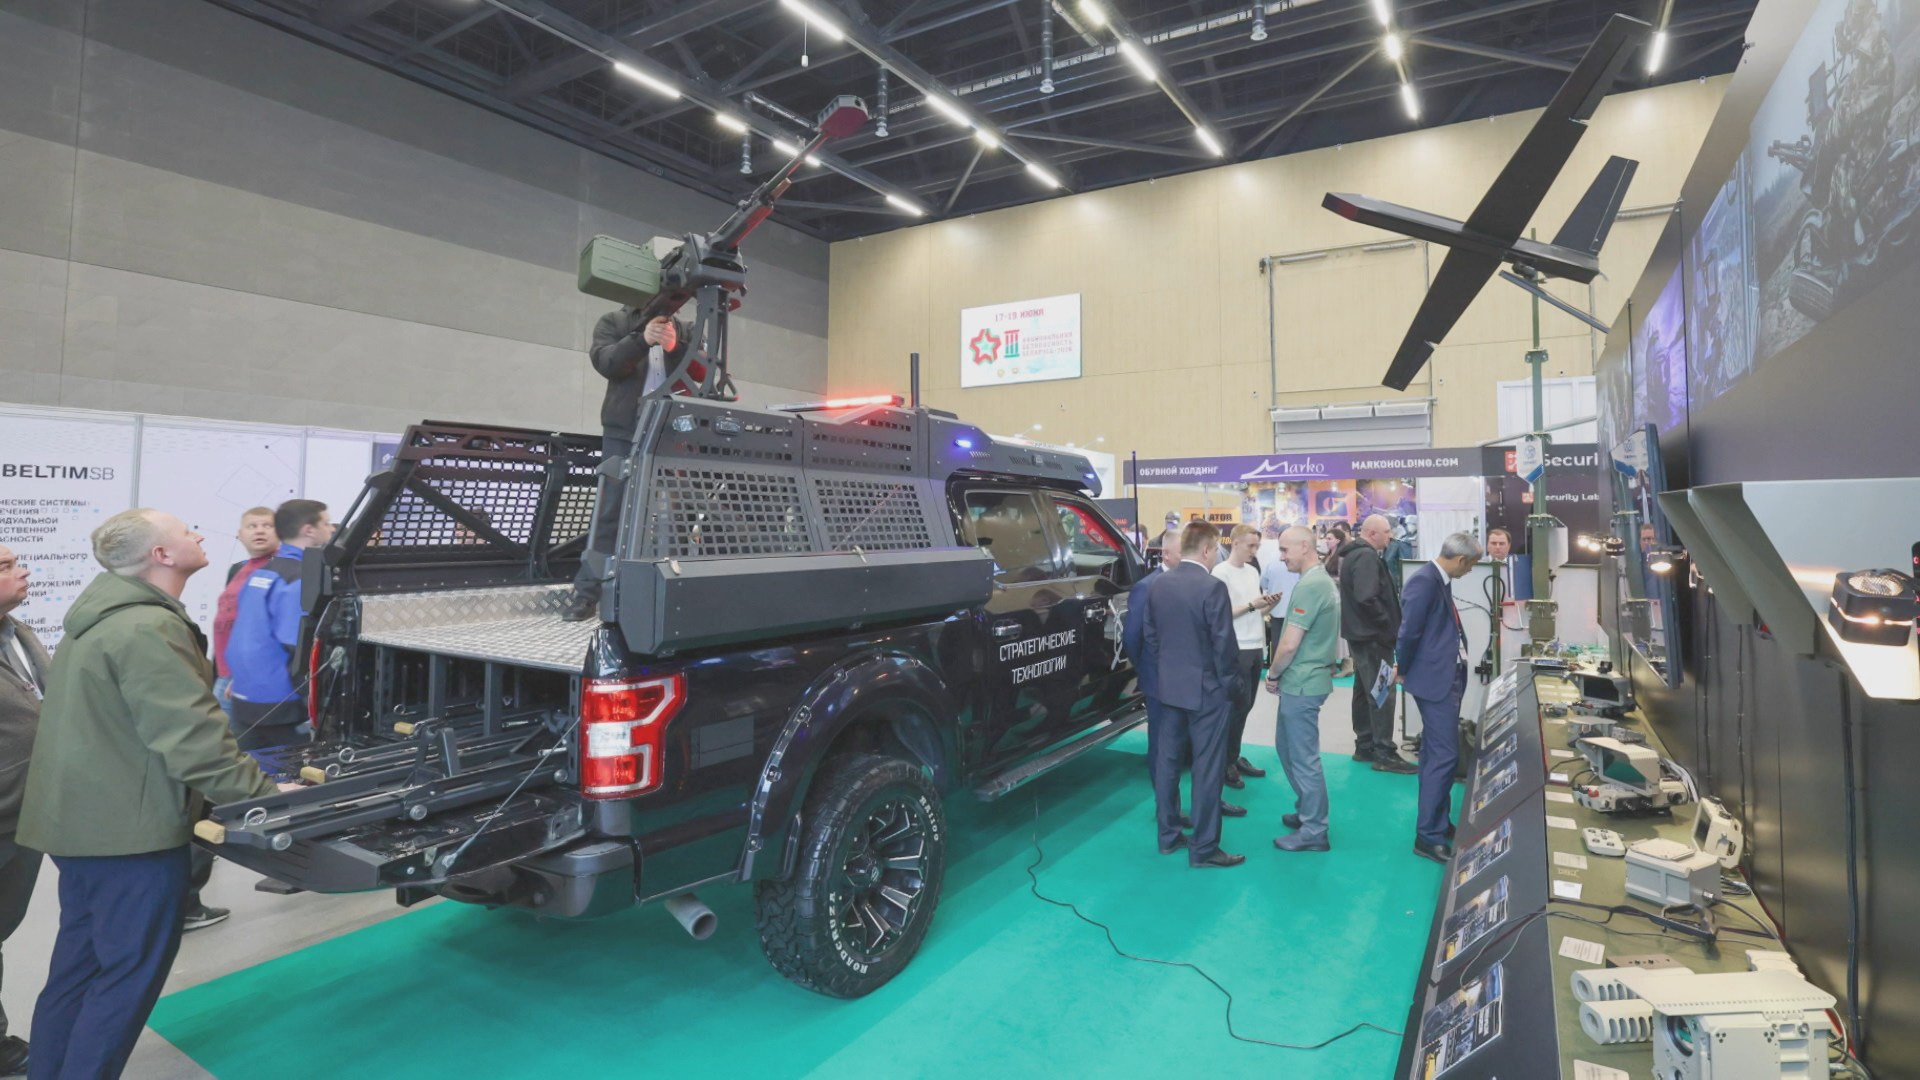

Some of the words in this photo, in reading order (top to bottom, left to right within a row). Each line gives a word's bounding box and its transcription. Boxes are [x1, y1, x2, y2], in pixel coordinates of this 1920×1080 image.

[1240, 457, 1328, 479] Marko
[1351, 457, 1459, 470] MARKOHOLDING.COM
[1139, 466, 1178, 476] ОБУВНОЙ
[1179, 466, 1218, 476] ХОЛДИНГ
[1545, 493, 1579, 502] ecurity
[16, 553, 88, 561] ПЕЦИАЛЬНОГО
[27, 580, 81, 588] АРУЖЕНИЯ
[1000, 629, 1076, 661] СТРАТЕГИЧЕСКИЕ
[1012, 655, 1067, 684] ТЕХНОЛОГИИ
